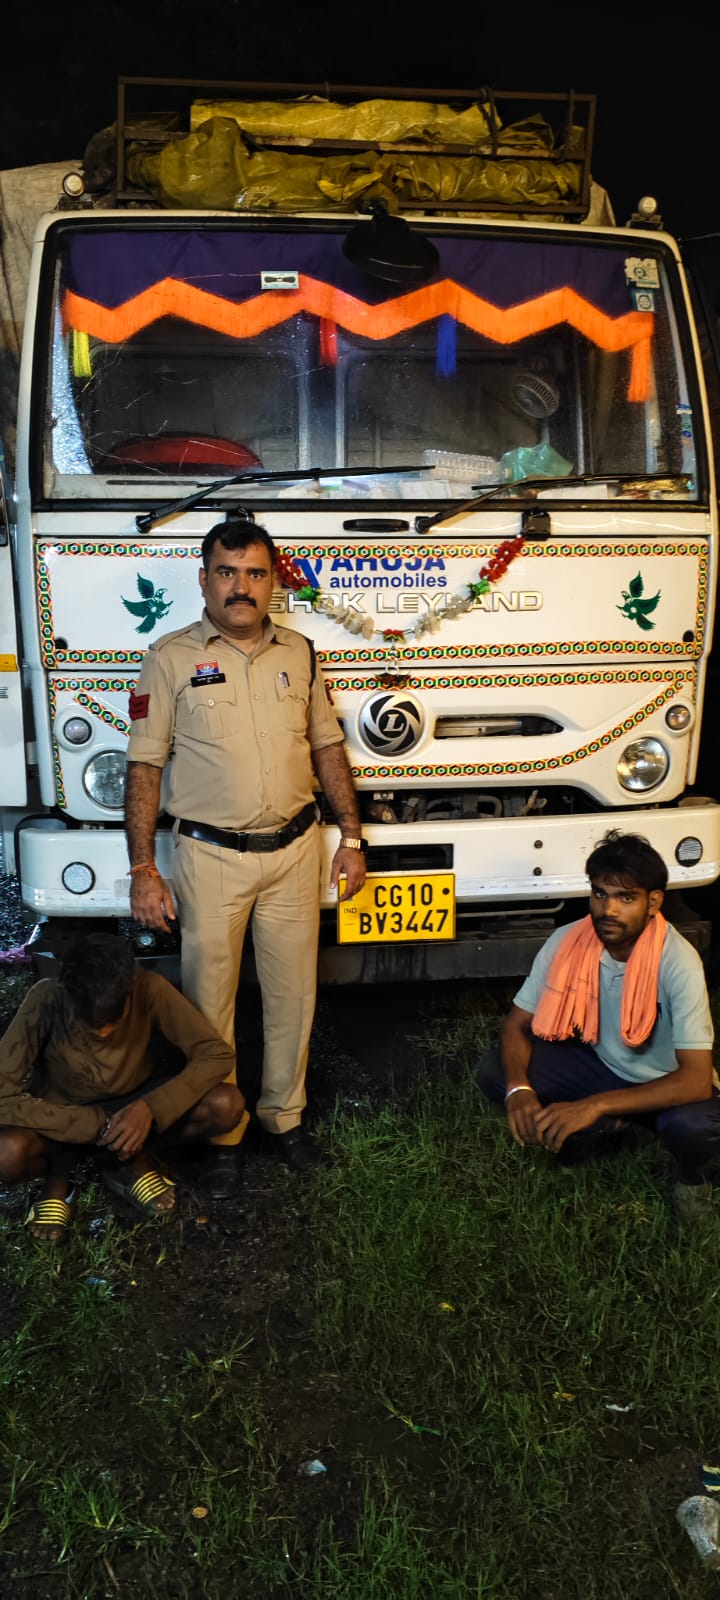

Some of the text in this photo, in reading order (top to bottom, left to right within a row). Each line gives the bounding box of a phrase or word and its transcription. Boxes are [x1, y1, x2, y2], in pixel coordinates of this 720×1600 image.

[329, 574, 447, 588] automobiles
[376, 591, 543, 613] LEYAND
[374, 883, 433, 908] CG10
[360, 909, 449, 935] BV3447
